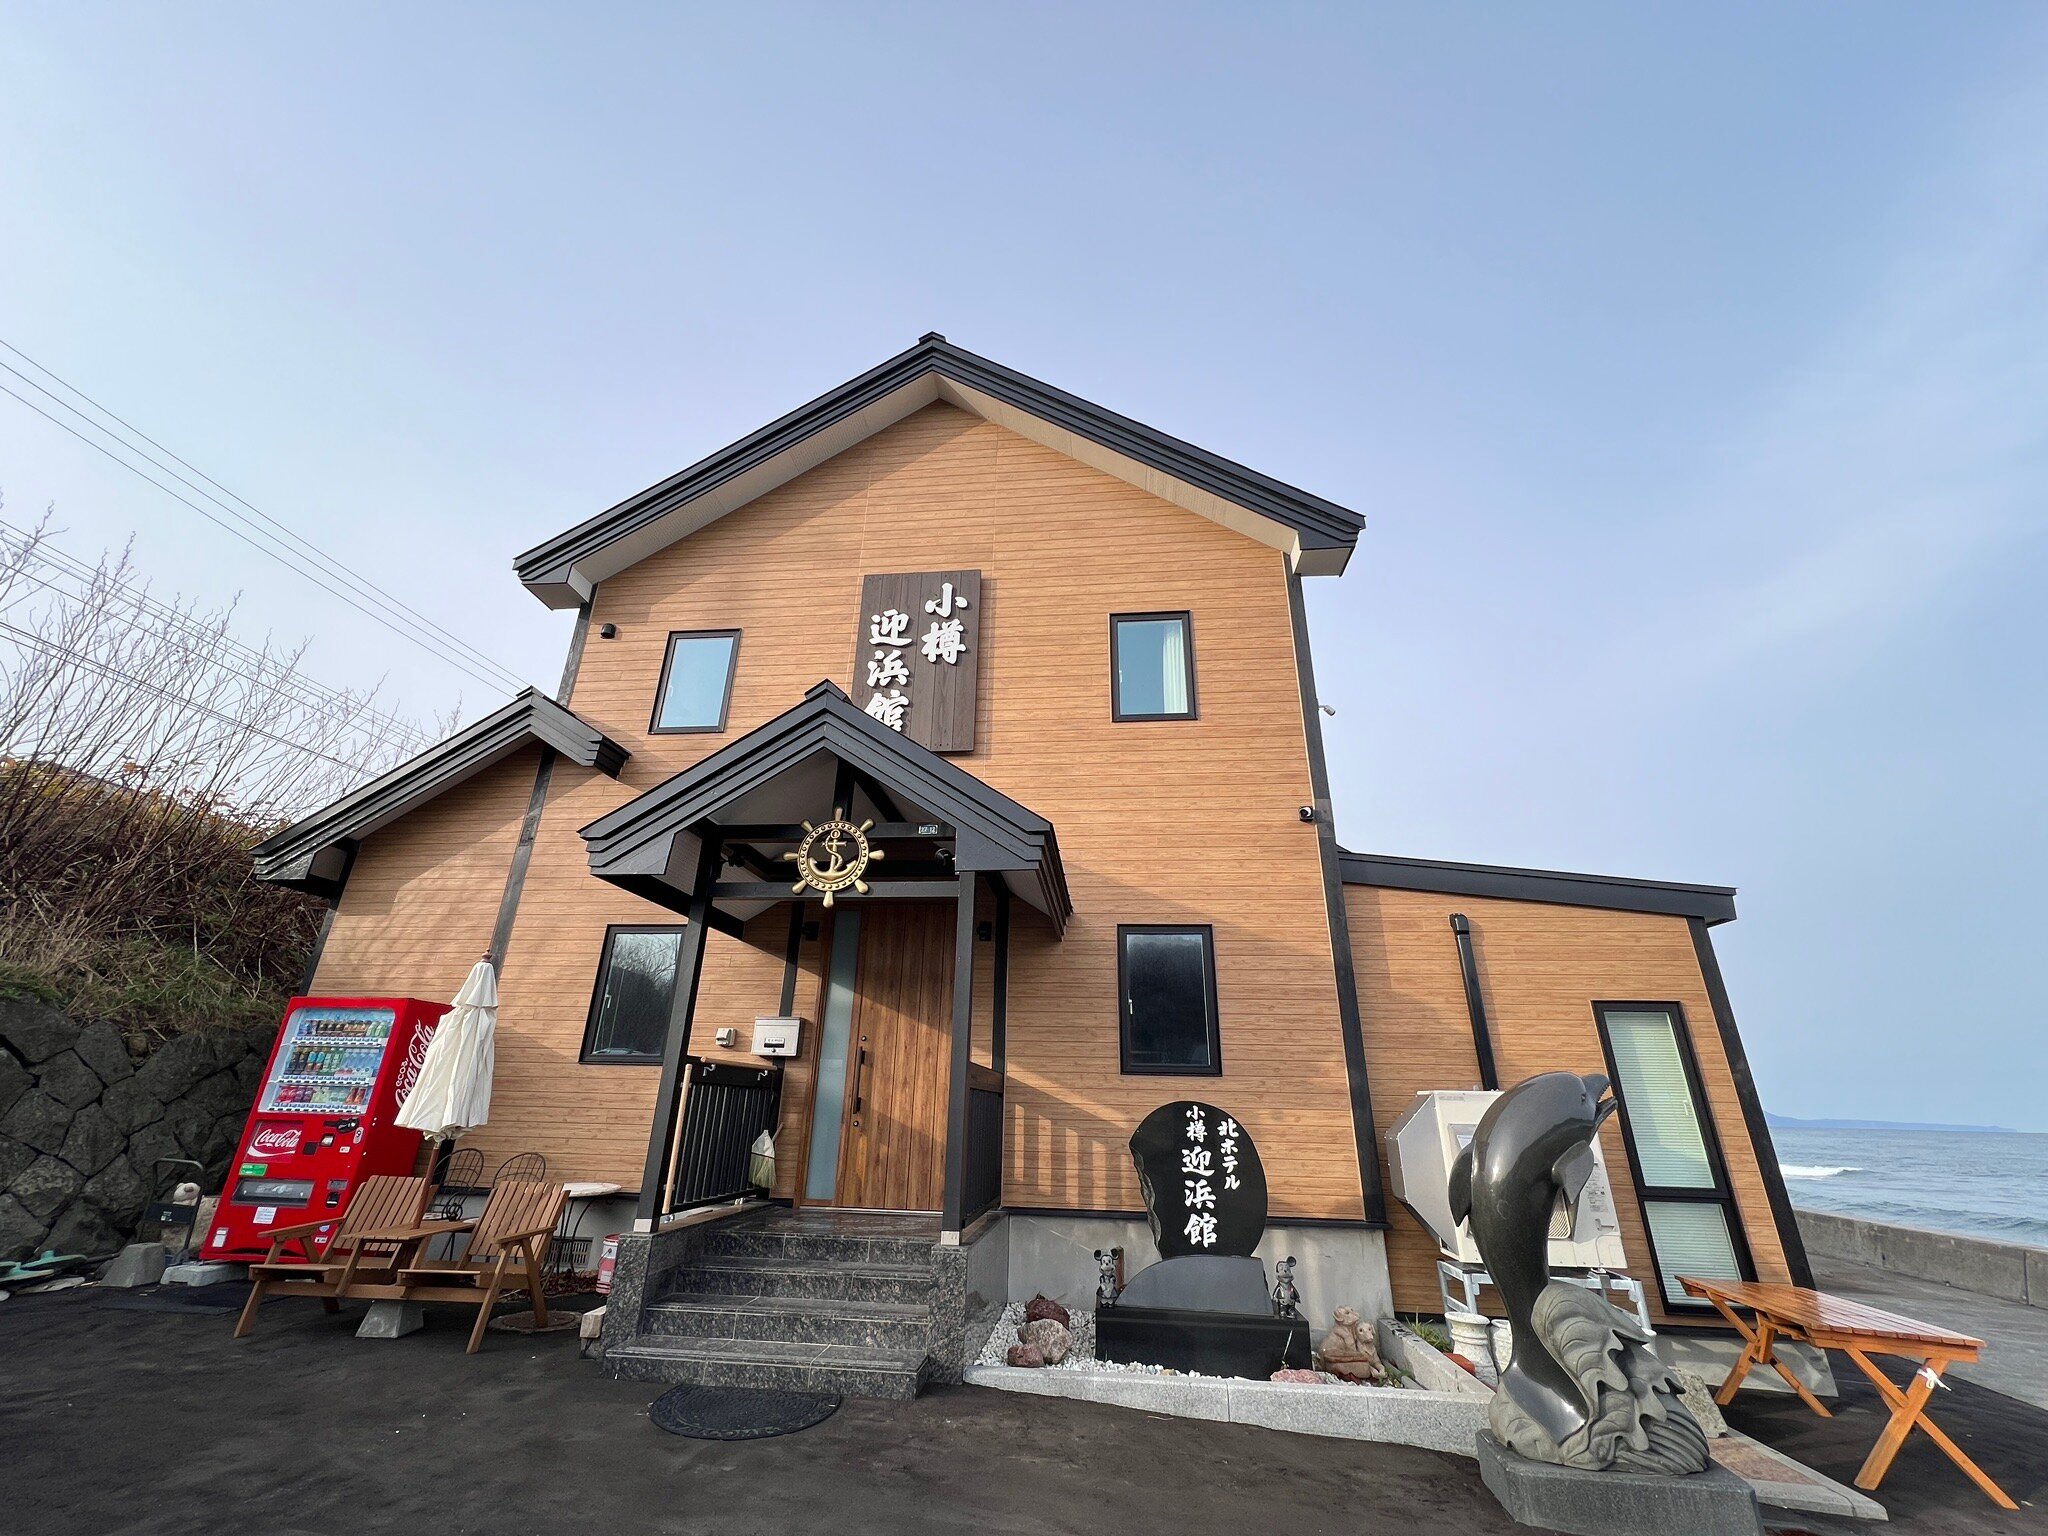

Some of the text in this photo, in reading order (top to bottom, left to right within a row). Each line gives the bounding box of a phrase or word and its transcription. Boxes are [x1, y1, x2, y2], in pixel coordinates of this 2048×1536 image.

[920, 582, 968, 665] 小樽
[1217, 1118, 1241, 1190] 北ホテル
